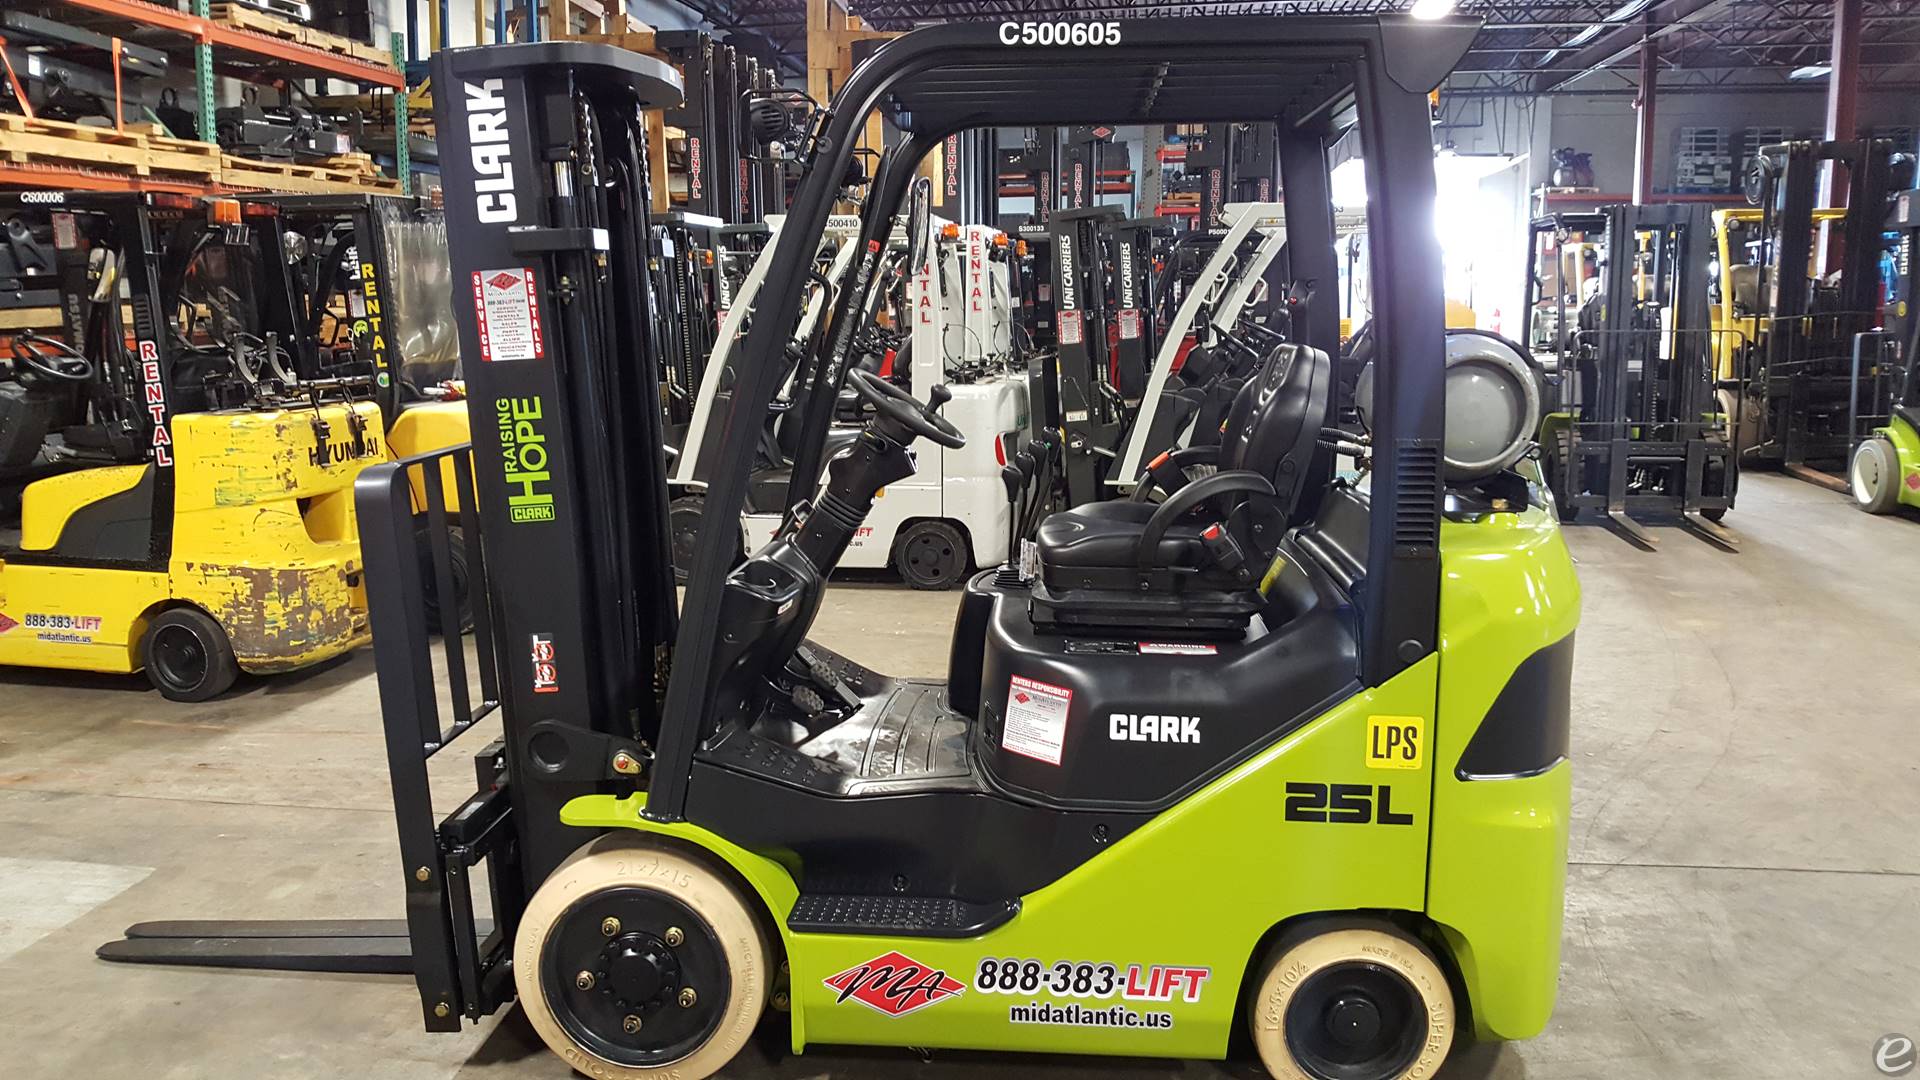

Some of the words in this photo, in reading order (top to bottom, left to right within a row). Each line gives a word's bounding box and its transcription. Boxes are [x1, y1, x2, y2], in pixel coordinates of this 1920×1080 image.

[999, 22, 1121, 46] C500605
[463, 78, 518, 224] CLARK
[690, 137, 702, 200] RENTAL
[946, 133, 957, 196] RENTAL
[739, 158, 749, 214] RENTAL
[1041, 171, 1050, 223] RENTAL
[1210, 169, 1221, 226] RENTAL
[970, 231, 982, 312] RENTAL
[1060, 234, 1075, 310] UNICARRIERS
[1121, 242, 1134, 309] UNICARRIERS
[1899, 234, 1910, 276] CLARK
[67, 293, 85, 354] OMATSU
[360, 263, 388, 369] RENTAL
[473, 274, 489, 357] SERVICE
[525, 271, 542, 353] RENTALS
[139, 340, 173, 467] RENTAL
[495, 397, 519, 473] RAISING
[505, 396, 553, 506] HOPE
[513, 506, 552, 521] CLARK
[37, 632, 92, 643] midatlantic.us
[1109, 713, 1201, 744] CLARK
[1372, 725, 1418, 761] LPS
[1285, 782, 1413, 825] 25L
[1010, 1003, 1172, 1028] midatlantic.us
